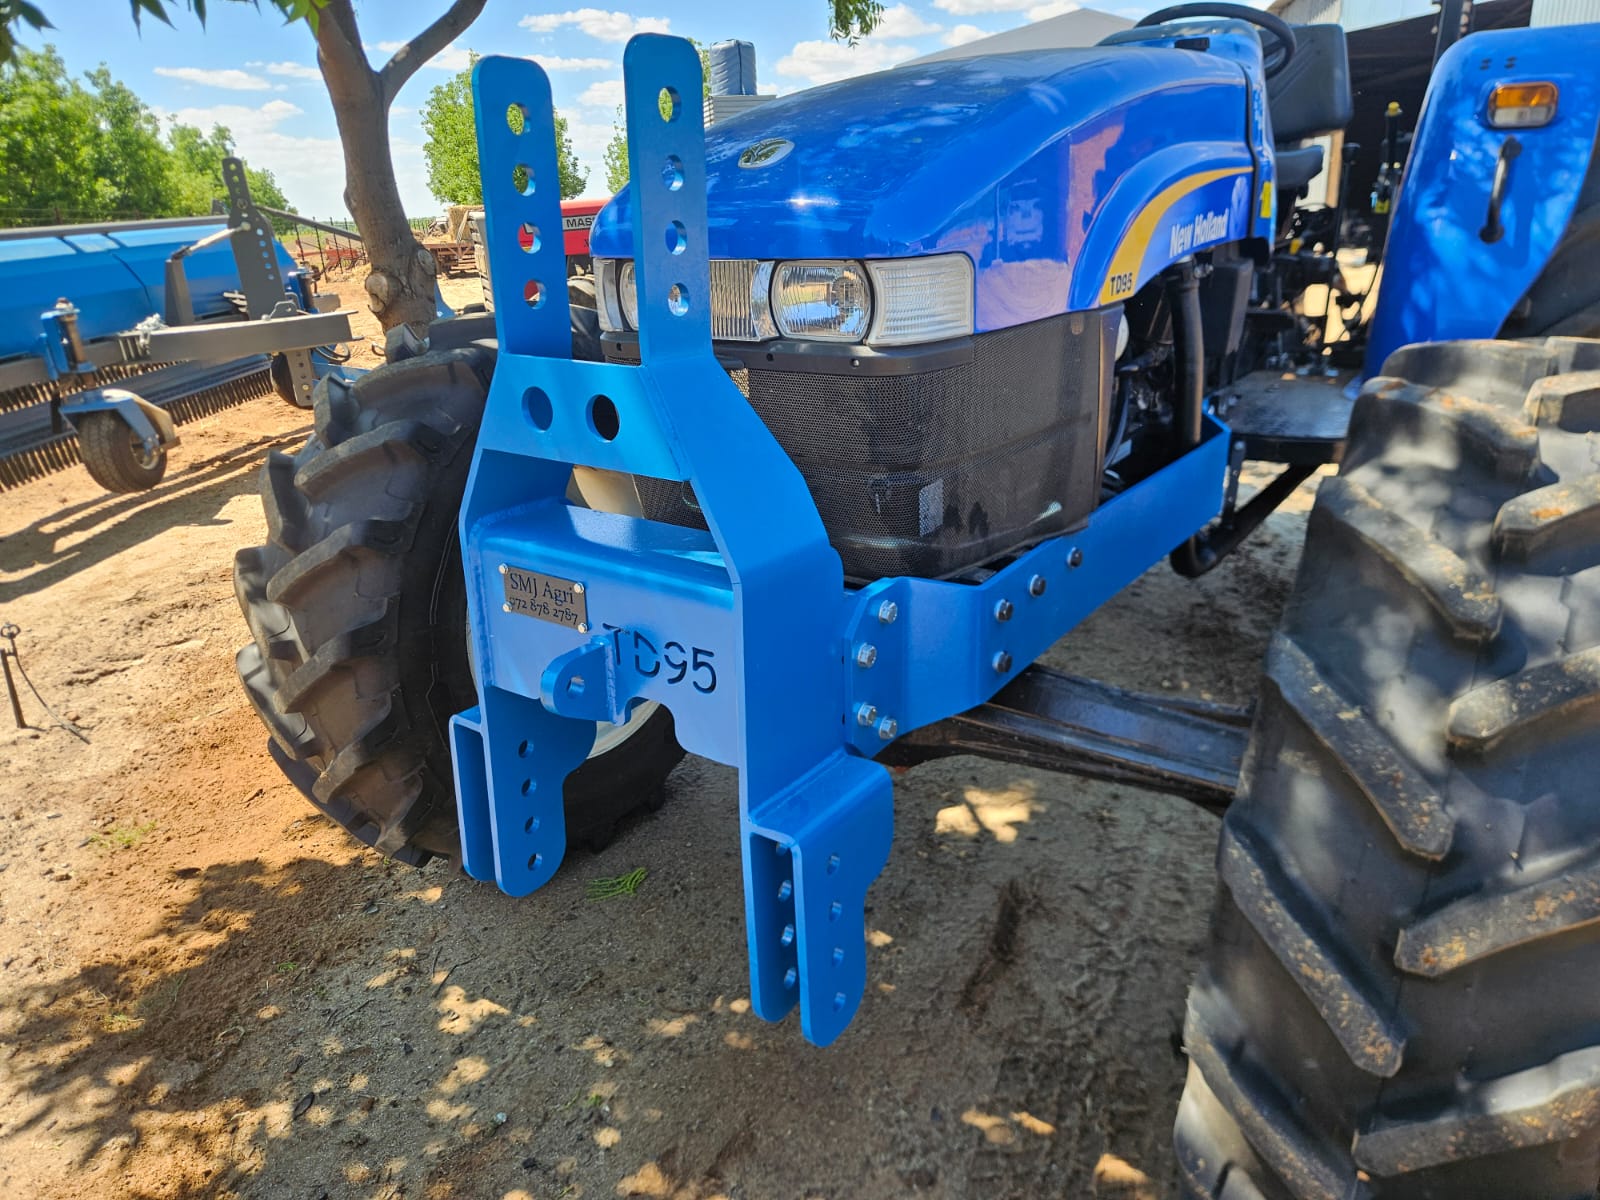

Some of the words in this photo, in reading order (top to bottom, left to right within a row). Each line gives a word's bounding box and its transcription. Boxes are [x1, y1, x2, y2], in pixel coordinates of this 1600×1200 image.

[566, 217, 595, 228] MAS
[1169, 223, 1193, 258] New
[1193, 208, 1228, 247] Holland
[1110, 273, 1132, 296] TD95
[509, 572, 538, 599] SMJ
[542, 581, 575, 607] Agri
[530, 598, 550, 617] 878
[552, 608, 578, 626] 2787
[603, 623, 717, 693] TD95
